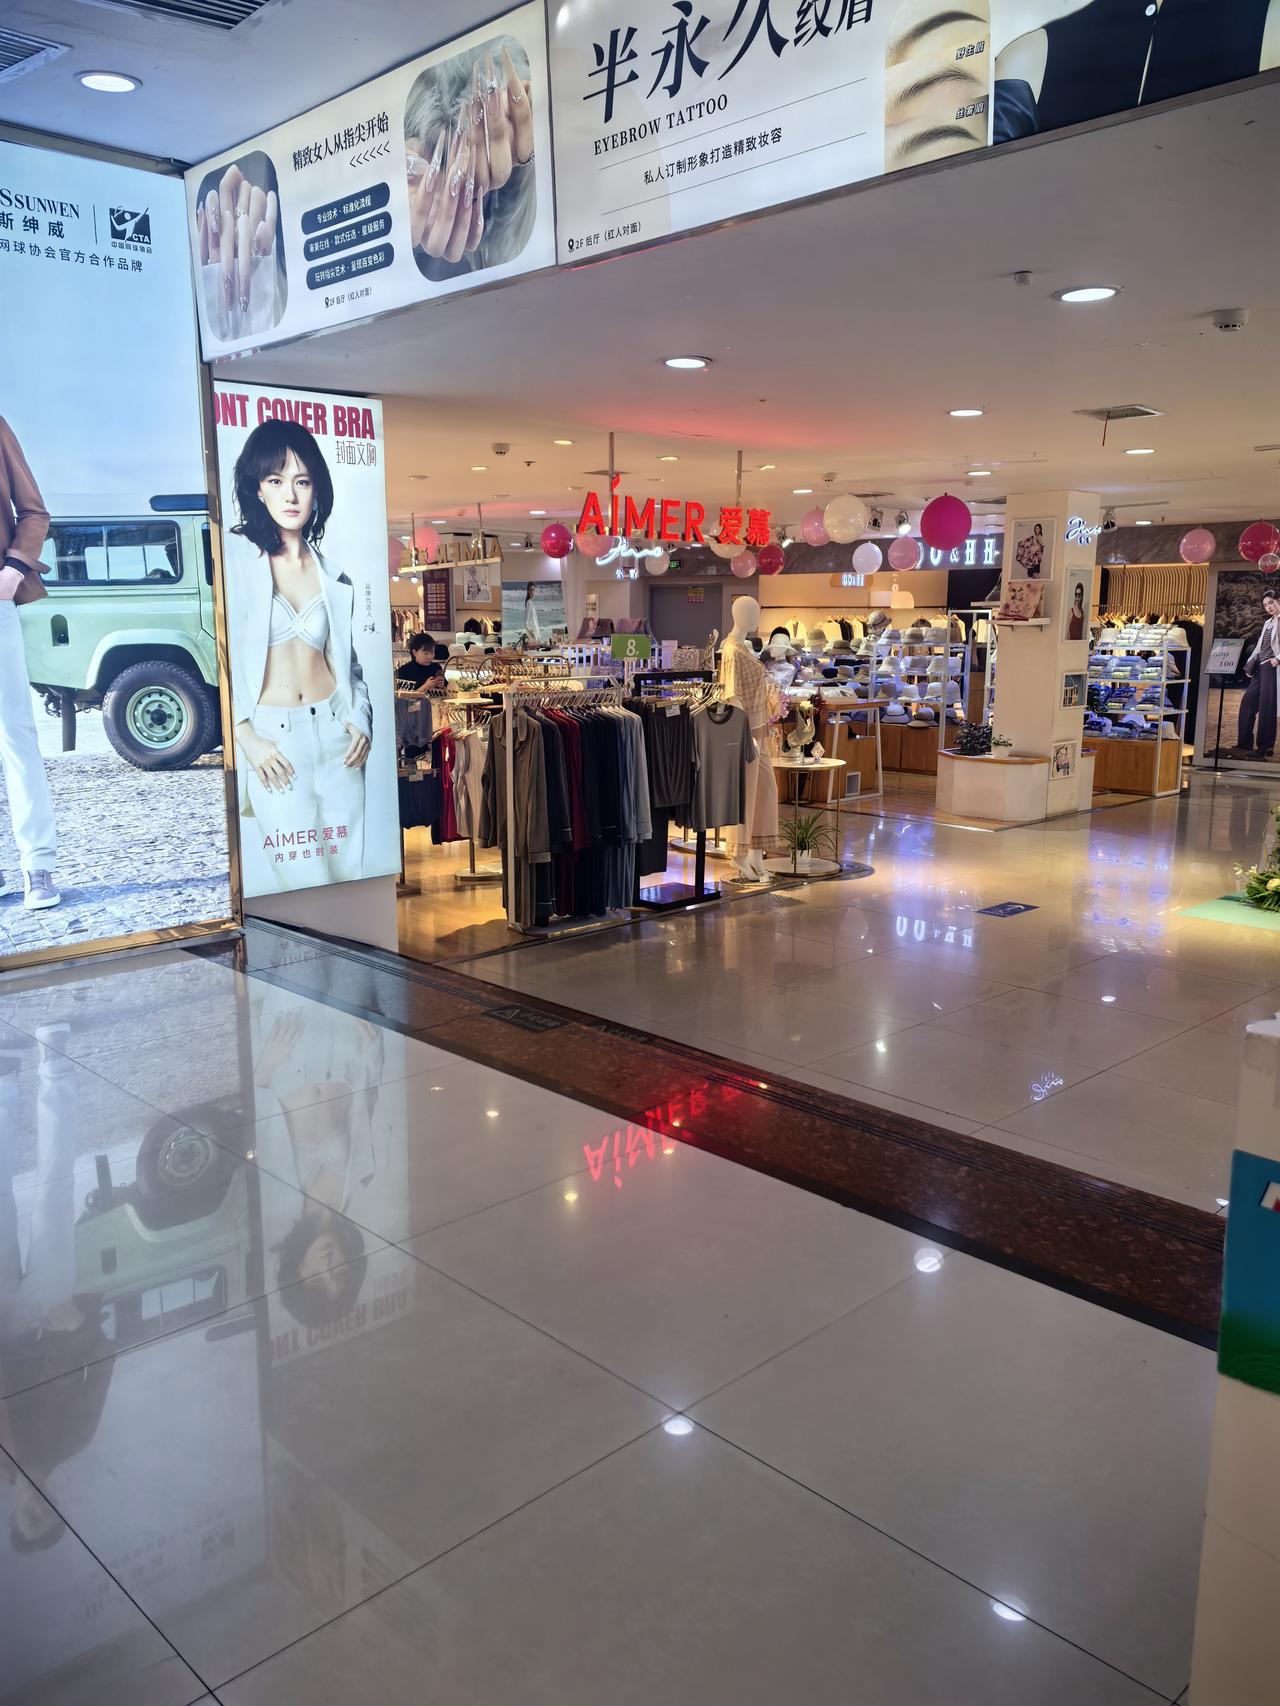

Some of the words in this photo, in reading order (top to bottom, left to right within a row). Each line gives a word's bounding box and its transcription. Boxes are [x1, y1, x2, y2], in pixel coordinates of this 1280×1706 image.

[292, 111, 389, 172] 精致女人从指尖开始
[594, 118, 661, 156] EYEBROW
[666, 94, 728, 130] TATTOO
[643, 128, 783, 186] 私人订制形象打造精致妆容
[0, 210, 65, 239] 斯绅威
[132, 233, 150, 244] CTA
[0, 239, 143, 273] 网球协会官方合作品牌
[575, 238, 585, 249] 2F
[257, 396, 328, 435] COVER
[333, 405, 375, 440] BRA
[335, 440, 377, 467] 封面文胸
[718, 506, 772, 546] 爱慕
[322, 825, 348, 841] 爱慕
